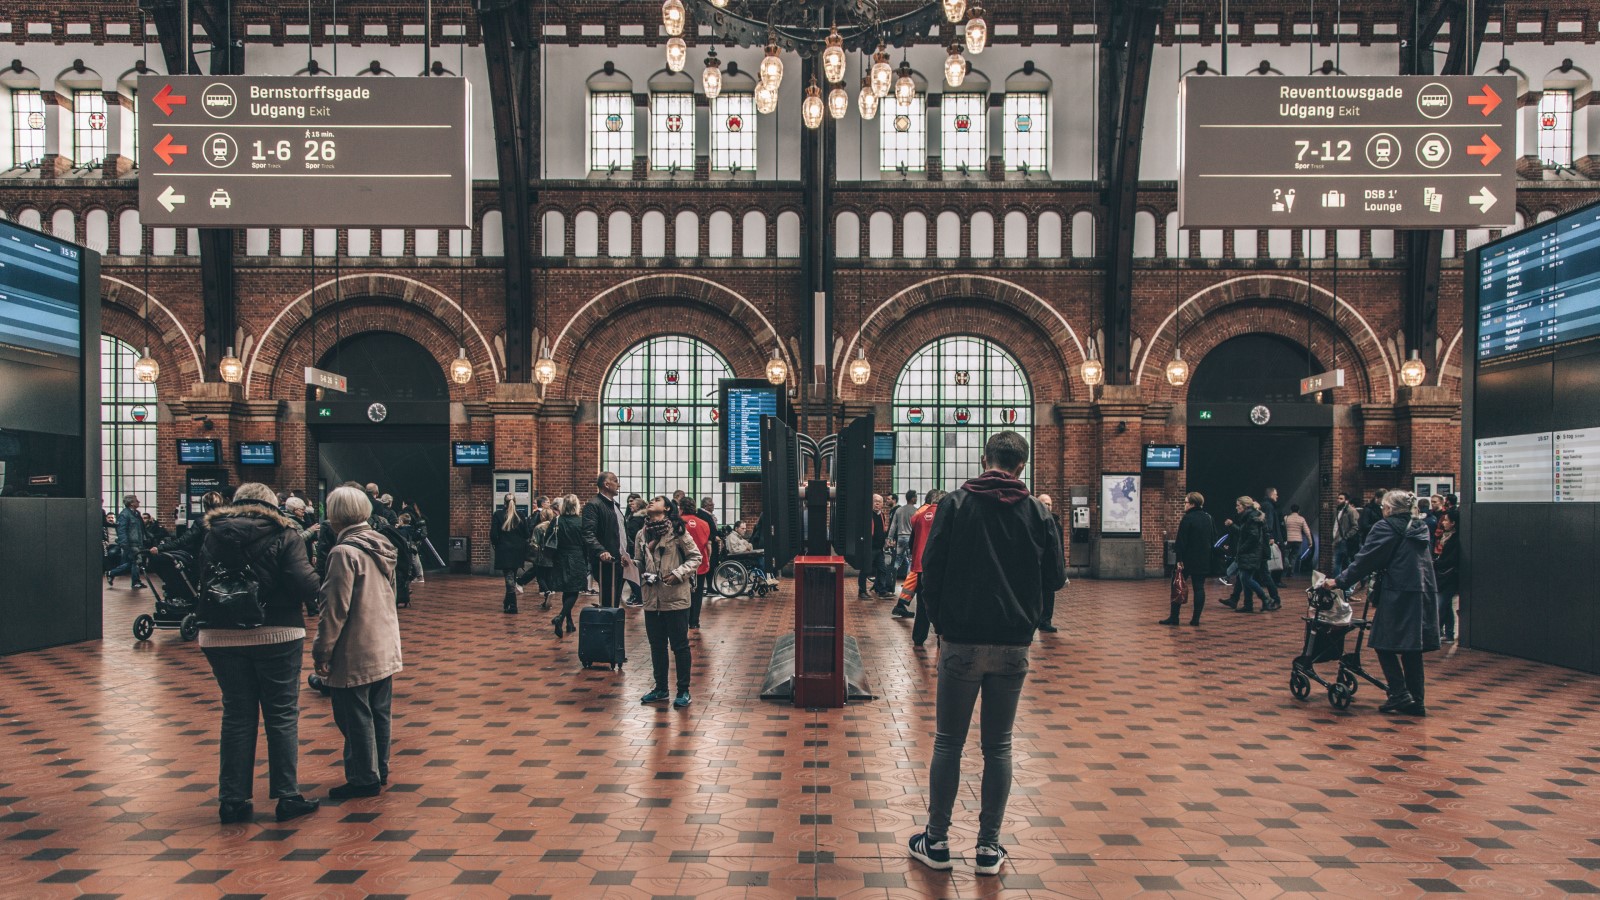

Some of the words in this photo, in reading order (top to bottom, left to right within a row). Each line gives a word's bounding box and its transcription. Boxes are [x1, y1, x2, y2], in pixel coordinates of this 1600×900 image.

[250, 86, 370, 101] Bernstorffsgade
[1280, 86, 1403, 101] Reventlowsgade
[250, 103, 305, 118] Udgang
[309, 105, 331, 116] Exit
[1279, 103, 1334, 118] Udgang
[1338, 105, 1360, 116] Exit
[252, 140, 291, 161] 1-6
[304, 140, 336, 161] 26
[1295, 140, 1352, 161] 7-12
[1364, 190, 1385, 199] DSB
[1364, 202, 1402, 213] Lounge
